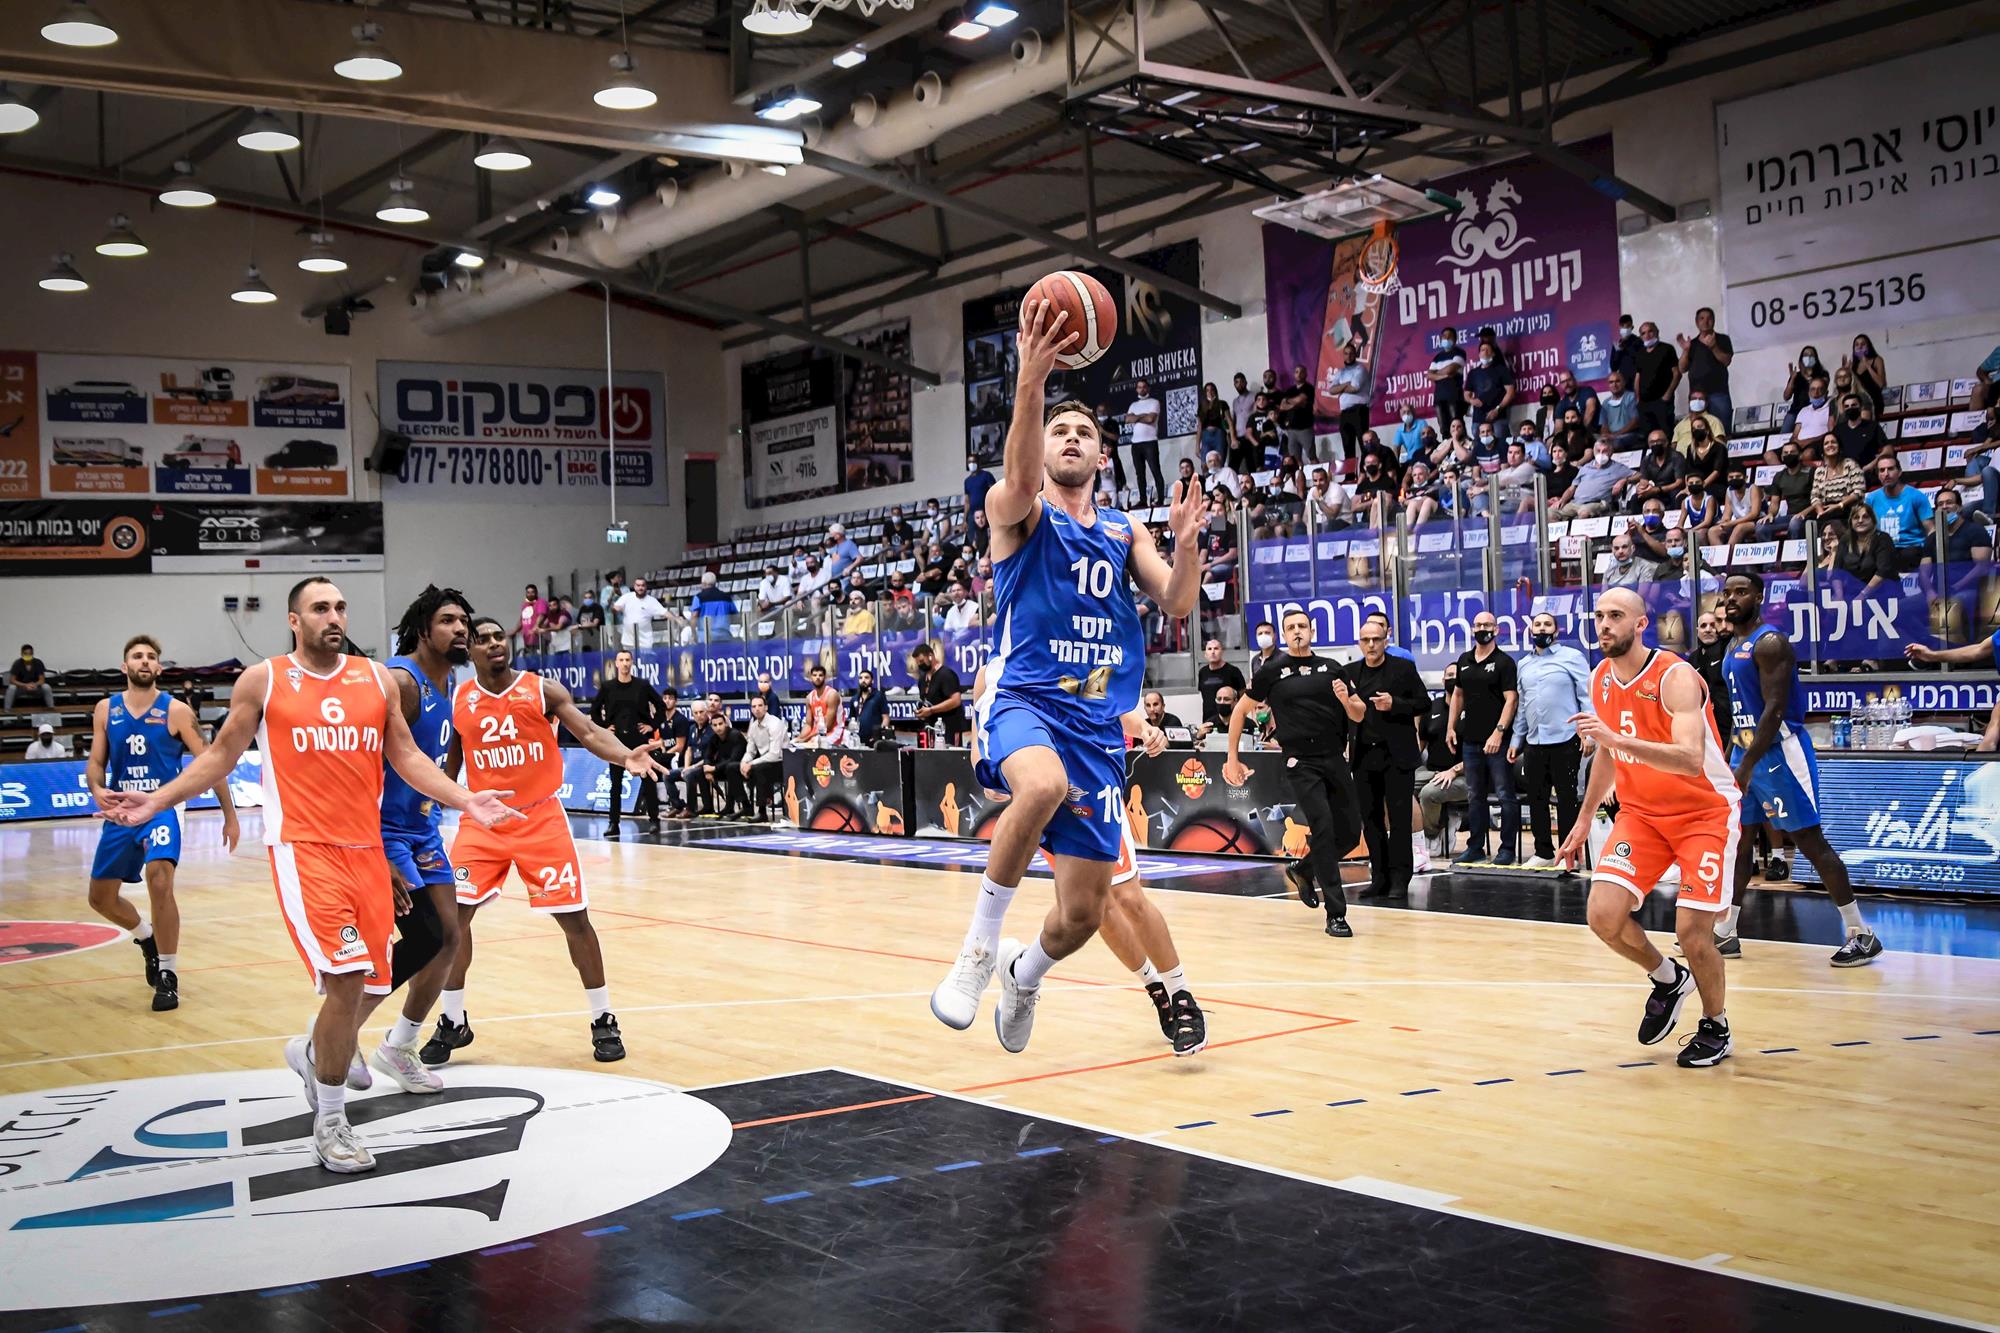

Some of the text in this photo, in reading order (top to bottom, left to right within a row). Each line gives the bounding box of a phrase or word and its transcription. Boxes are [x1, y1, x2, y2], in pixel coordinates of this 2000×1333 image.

[1746, 105, 1995, 193] יוסי אברהמי
[1824, 172, 1908, 209] איכות
[1746, 195, 1804, 225] חיים
[1399, 249, 1582, 326] קניון מול הים
[1751, 273, 1926, 328] 08-6325136
[1506, 316, 1525, 336] ללא
[1528, 313, 1551, 334] קניון
[1131, 347, 1196, 378] KOBI SHVEKA
[1520, 347, 1559, 372] הורידו
[396, 378, 596, 437] פטקום
[397, 424, 460, 437] ELECTRIC
[482, 426, 597, 440] חשמל ומחשבים
[567, 463, 598, 473] BIG
[613, 455, 645, 466] במחי
[567, 475, 599, 486] החדש
[36, 519, 73, 537] במות
[77, 519, 101, 536] יוסי
[200, 517, 260, 527] ASX
[199, 529, 261, 541] 2018
[1749, 546, 1759, 556] מול
[1759, 545, 1777, 556] קניון
[1071, 556, 1114, 598] 10
[1072, 615, 1112, 640] יוסי
[1788, 589, 1900, 643] אילת
[849, 644, 892, 678] אילת
[1049, 639, 1123, 666] אברהמי
[566, 666, 587, 688] יוסי
[700, 655, 793, 682] יוסי אברהמי
[320, 697, 346, 723] 6
[1808, 692, 1821, 711] גן
[439, 719, 450, 747] 0
[480, 714, 518, 743] 24
[1619, 710, 1637, 738] 5
[126, 734, 146, 755] 18
[292, 725, 378, 753] חי מוטורס
[529, 741, 544, 762] חי
[473, 743, 525, 770] מוטורס
[1175, 773, 1204, 785] Winner
[1097, 784, 1122, 824] 10
[1774, 797, 1788, 818] 2
[150, 825, 170, 847] 18
[539, 862, 578, 892] 24
[1698, 851, 1720, 882] 5
[1874, 863, 1965, 881] 1920-2020
